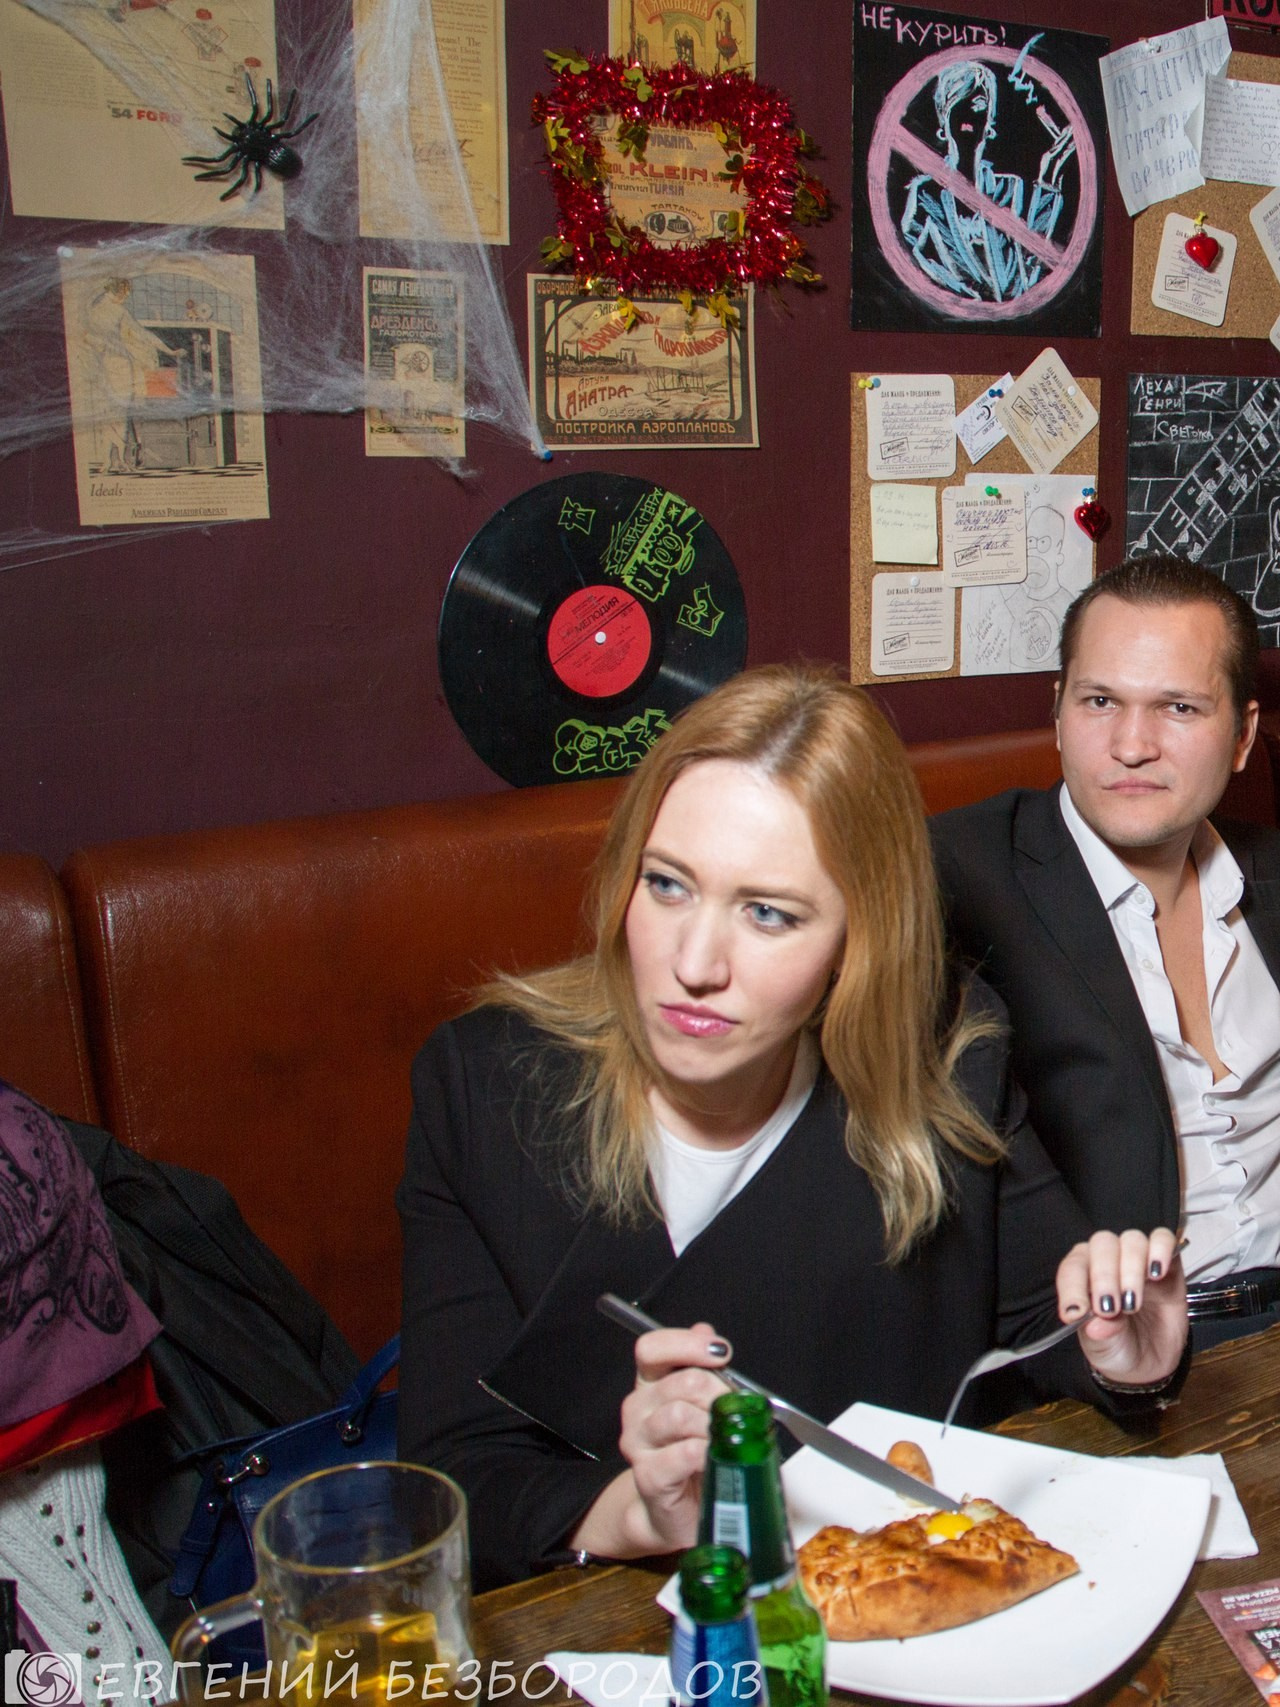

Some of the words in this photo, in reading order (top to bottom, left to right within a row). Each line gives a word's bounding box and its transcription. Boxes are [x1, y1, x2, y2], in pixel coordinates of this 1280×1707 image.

[862, 3, 895, 29] НЕ
[895, 17, 1006, 47] КУРИТЬ!
[629, 162, 708, 182] KLEIN
[1133, 375, 1174, 396] ЛЁХА
[566, 384, 634, 419] АНАТРА
[1137, 395, 1182, 413] ГЕНРИ
[599, 406, 655, 418] ОДЕССА
[555, 421, 636, 434] ПОСТРОЙКА
[642, 422, 736, 434] АЭРОПЛАНОВЪ
[89, 483, 123, 497] Ideals
[574, 596, 620, 634] МЕЛОДИЯ
